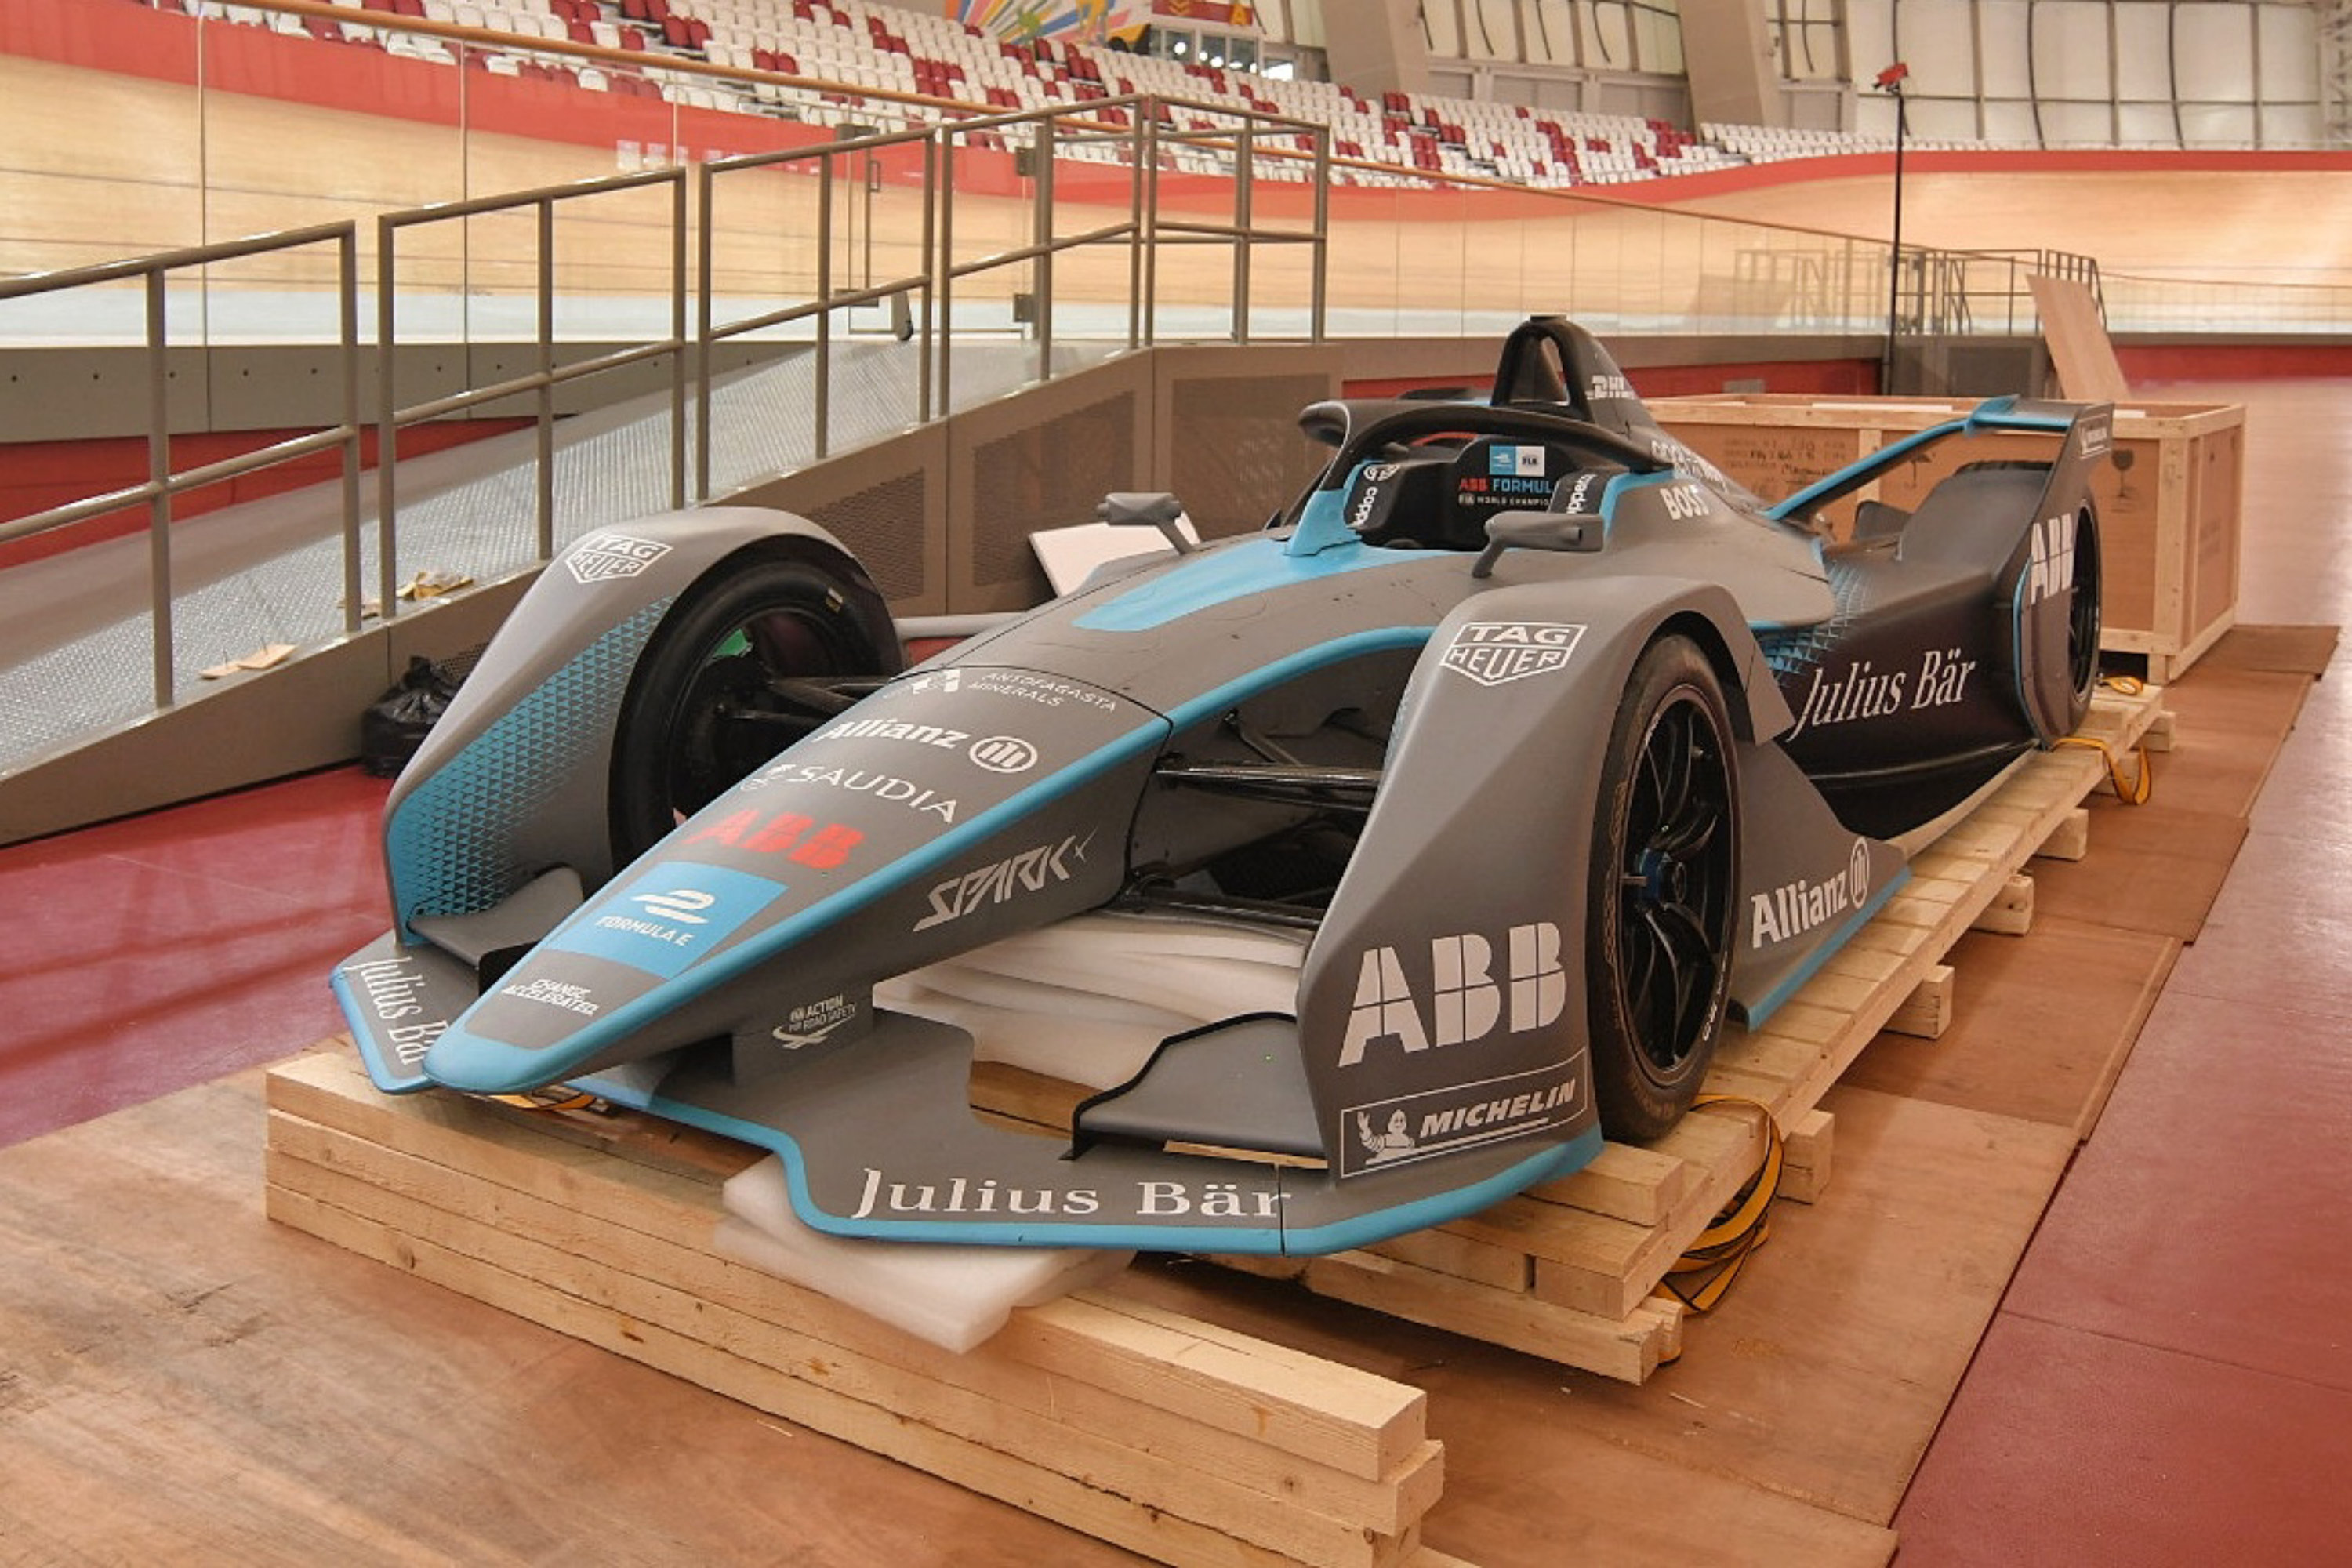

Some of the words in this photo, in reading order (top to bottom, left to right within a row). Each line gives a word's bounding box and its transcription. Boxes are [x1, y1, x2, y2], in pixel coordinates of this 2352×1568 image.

[1592, 375, 1631, 399] DHL
[1460, 477, 1489, 492] ABB
[1493, 477, 1552, 493] FORMUL
[573, 552, 641, 579] HEUER
[597, 538, 659, 559] TAG
[2031, 512, 2074, 605] ABB
[1469, 626, 1570, 644] TAG
[1449, 648, 1563, 680] HEUER
[968, 682, 1064, 707] MINERALS
[982, 672, 1116, 713] ANTOFAGASTA
[1786, 661, 1907, 742] Julius
[1911, 648, 1976, 710] Bär
[811, 718, 970, 750] Allianz
[784, 764, 958, 825] SAUDIA
[680, 808, 865, 870] ABB
[912, 834, 1076, 932] SPARK
[1751, 870, 1848, 949] Allianz
[594, 915, 674, 943] FORMULA
[673, 933, 694, 946] E
[343, 956, 426, 1019] Julius
[807, 993, 843, 1017] ACTION
[1337, 922, 1566, 1068] ABB
[803, 1013, 826, 1031] ROAD
[827, 1003, 857, 1023] SAFETY
[1419, 1078, 1576, 1138] MICHELIN
[851, 1167, 1099, 1219] Julius
[1135, 1181, 1292, 1218] Bär
